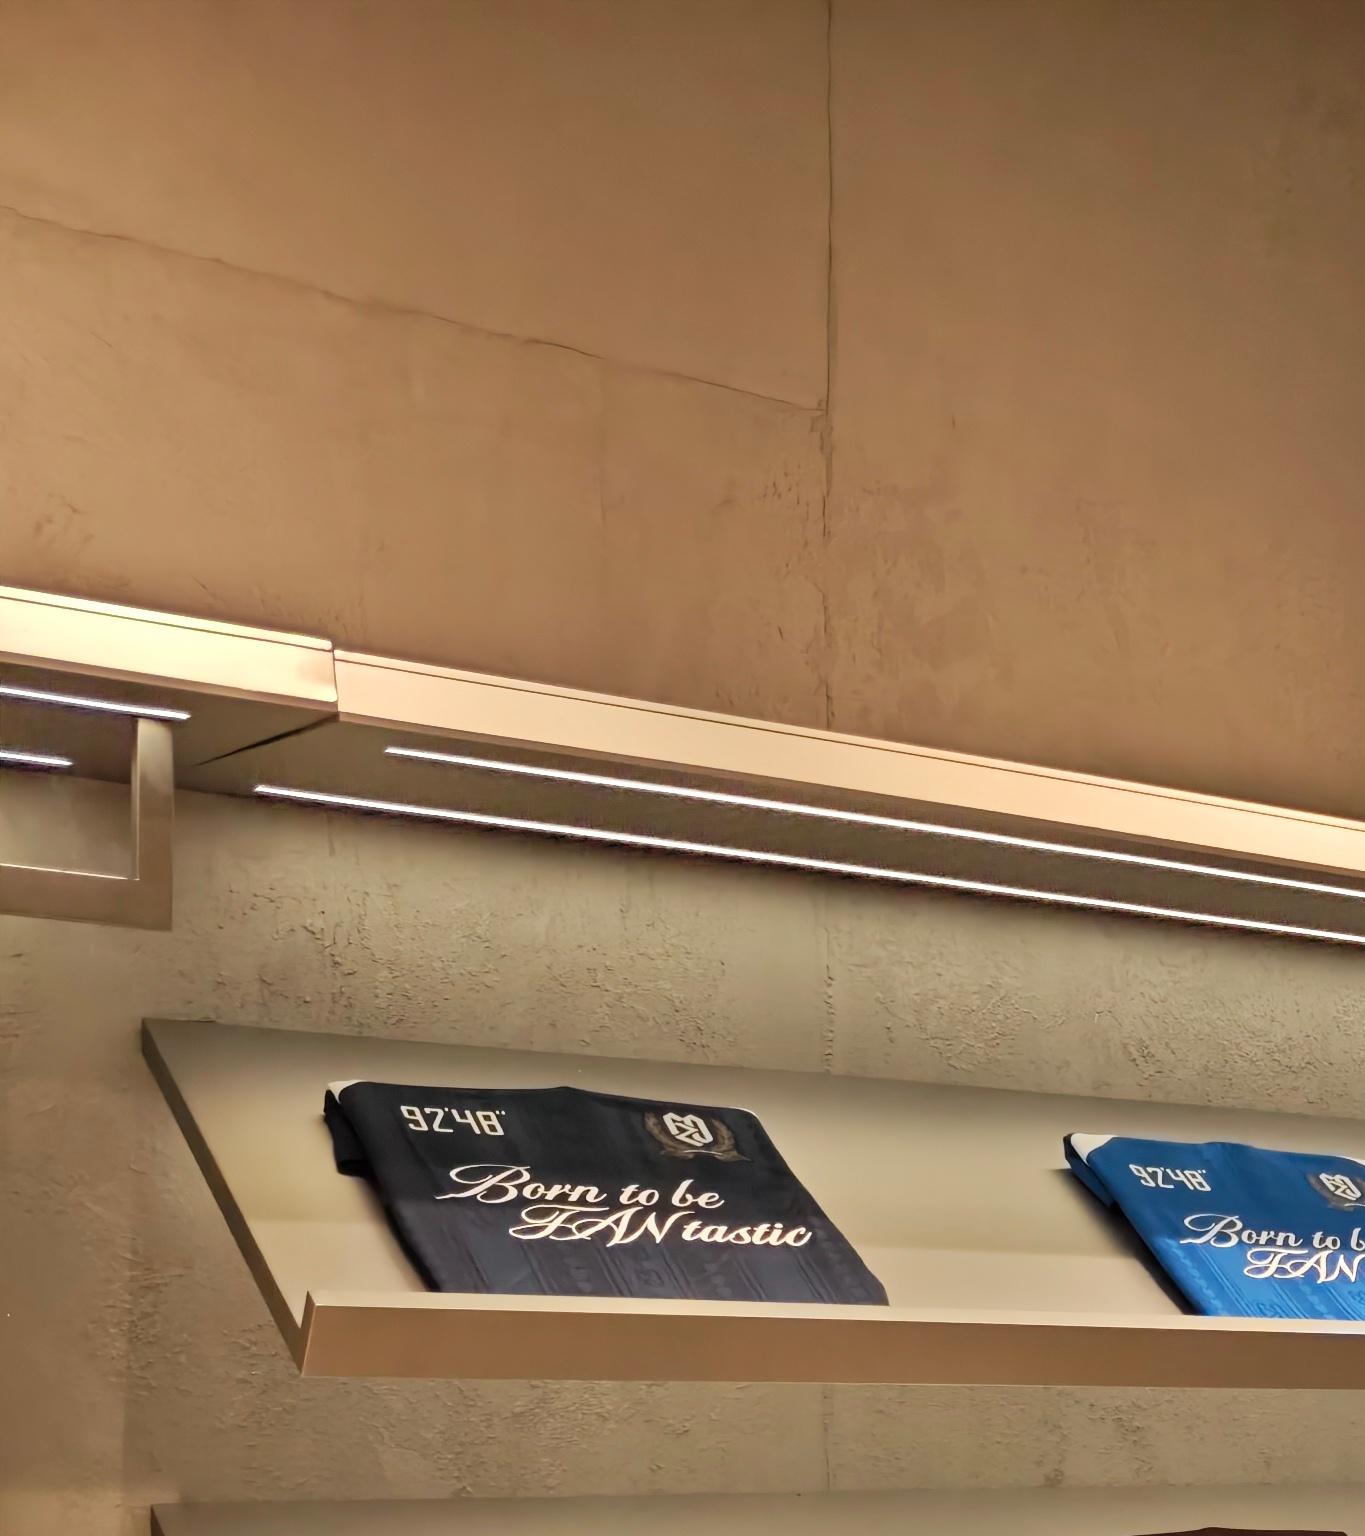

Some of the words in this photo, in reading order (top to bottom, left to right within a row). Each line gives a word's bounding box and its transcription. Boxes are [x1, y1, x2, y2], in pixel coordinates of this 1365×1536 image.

[434, 1164, 607, 1204] Born
[620, 1184, 660, 1208] to
[671, 1179, 725, 1209] be
[509, 1205, 812, 1248] FANtastic
[1179, 1213, 1302, 1248] Born
[1311, 1230, 1342, 1251] to
